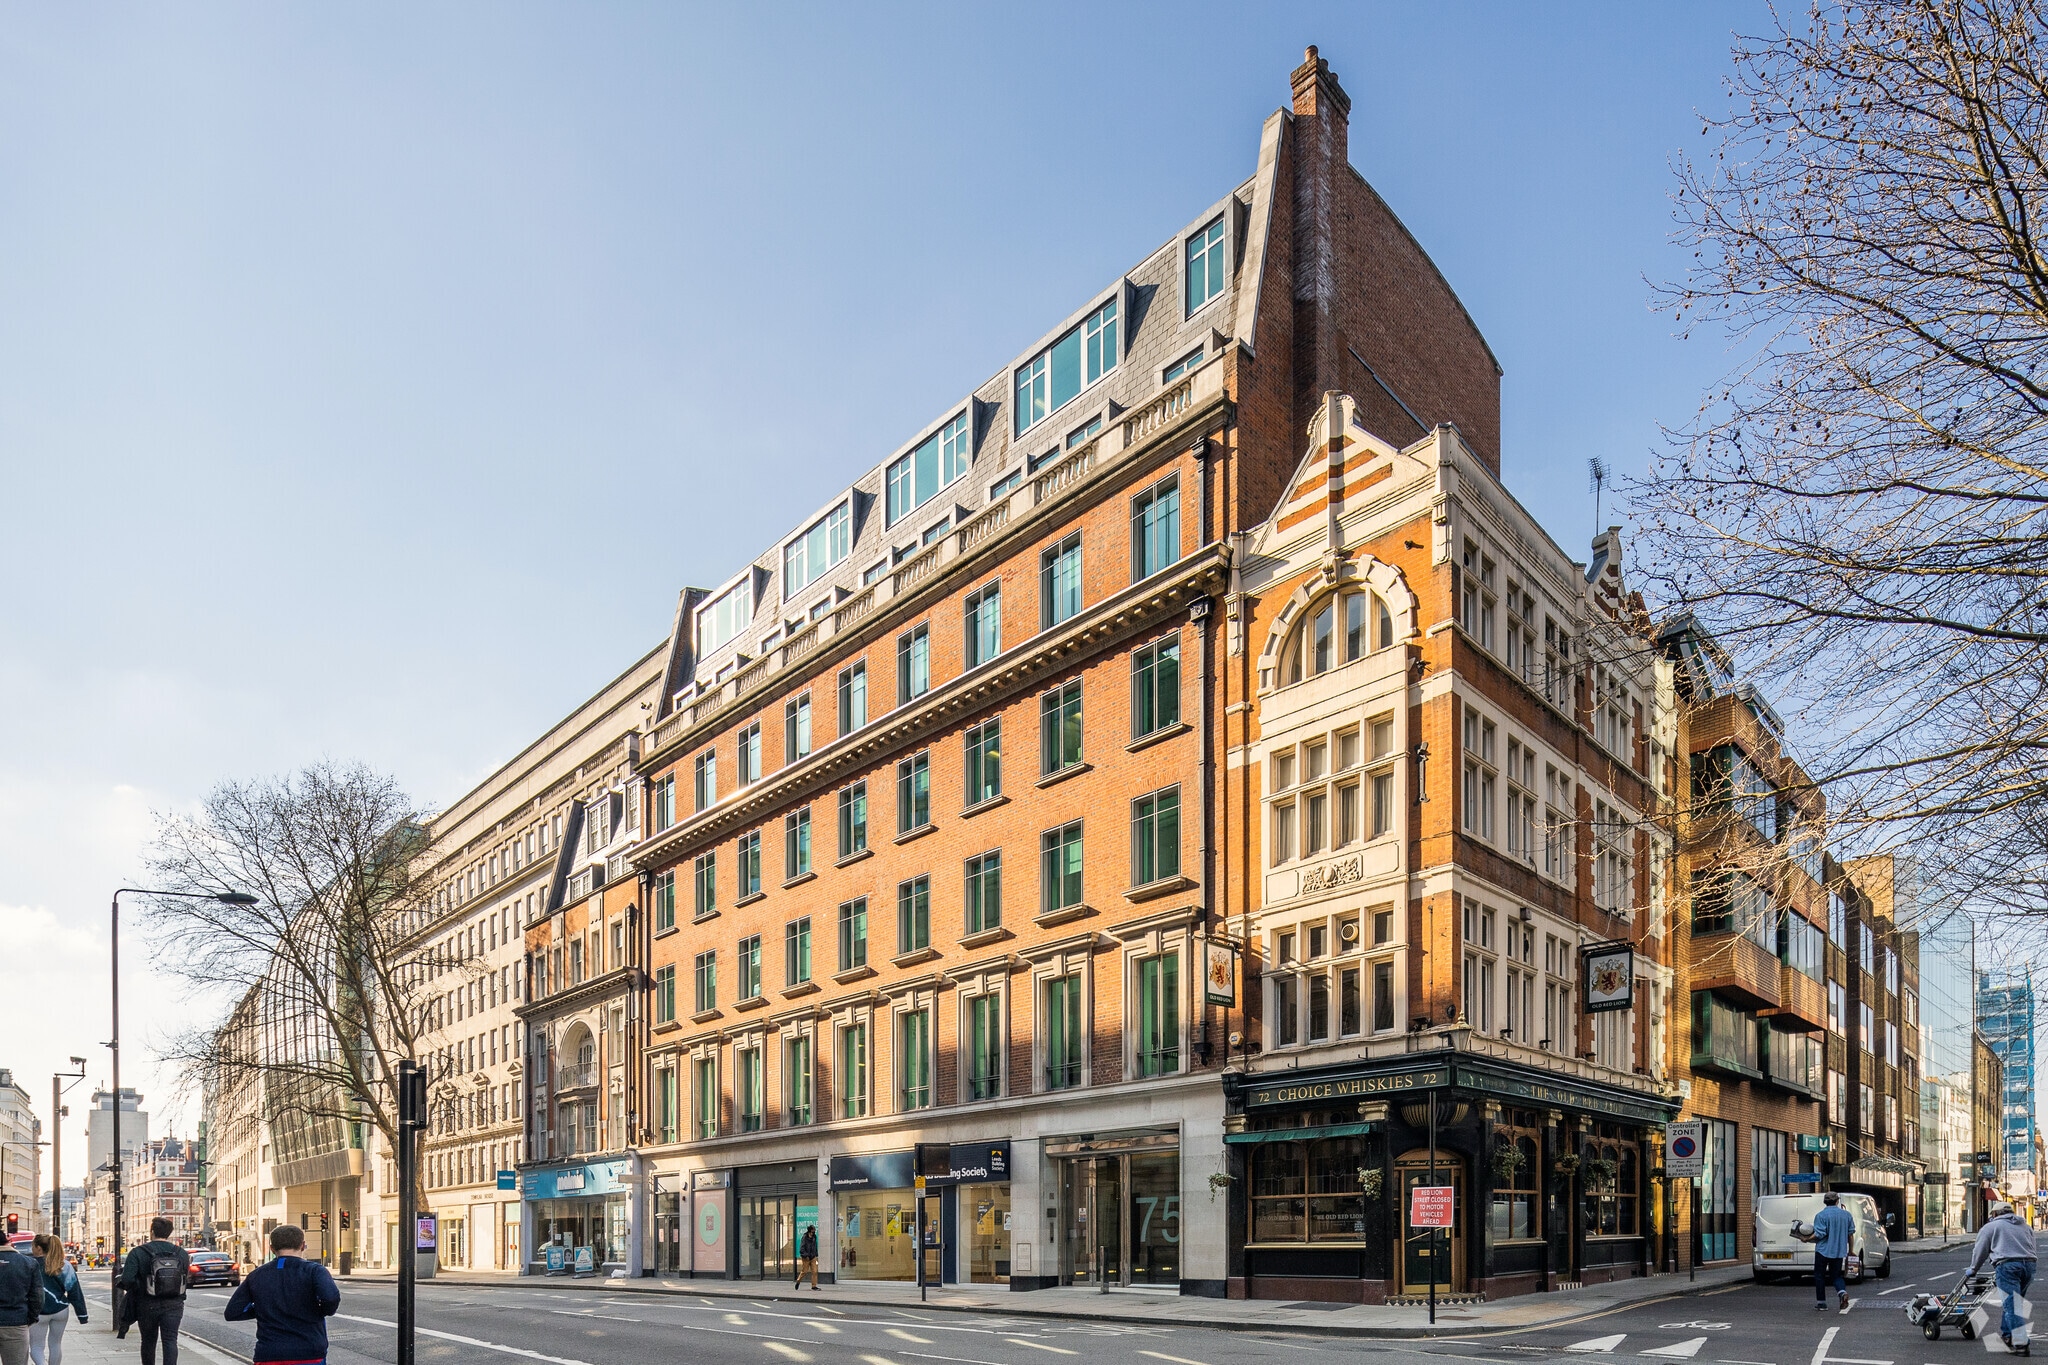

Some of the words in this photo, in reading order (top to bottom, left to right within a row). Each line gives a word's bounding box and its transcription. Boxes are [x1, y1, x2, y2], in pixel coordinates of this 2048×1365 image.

[1258, 1093, 1270, 1102] 72
[1278, 1084, 1333, 1101] CHOICE
[1337, 1074, 1413, 1094] WHISKIES
[1422, 1073, 1437, 1084] 72
[961, 1167, 988, 1178] Society
[1135, 1195, 1180, 1243] 75
